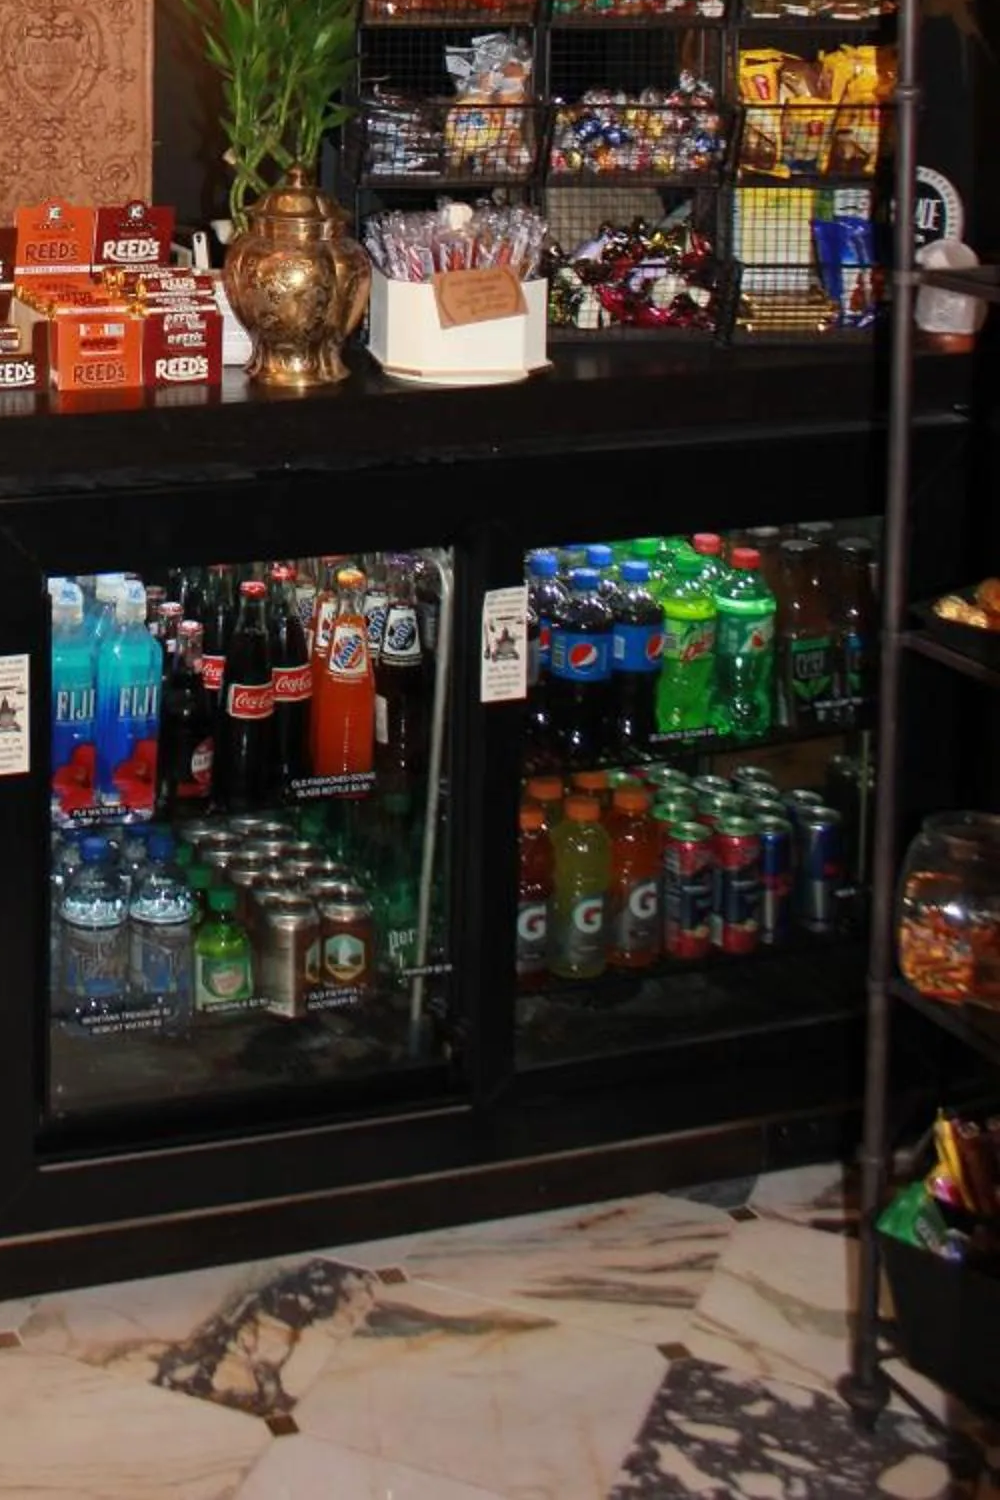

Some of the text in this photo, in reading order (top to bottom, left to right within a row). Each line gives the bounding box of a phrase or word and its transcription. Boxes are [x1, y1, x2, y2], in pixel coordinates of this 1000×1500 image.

[25, 241, 79, 264] REED'S
[103, 237, 161, 263] REED'S
[73, 360, 126, 387] REED'S
[155, 355, 209, 381] REED'S
[56, 688, 96, 721] FIJI
[119, 685, 158, 717] FIJI
[576, 899, 603, 933] G
[630, 883, 657, 919] G
[517, 906, 546, 941] G
